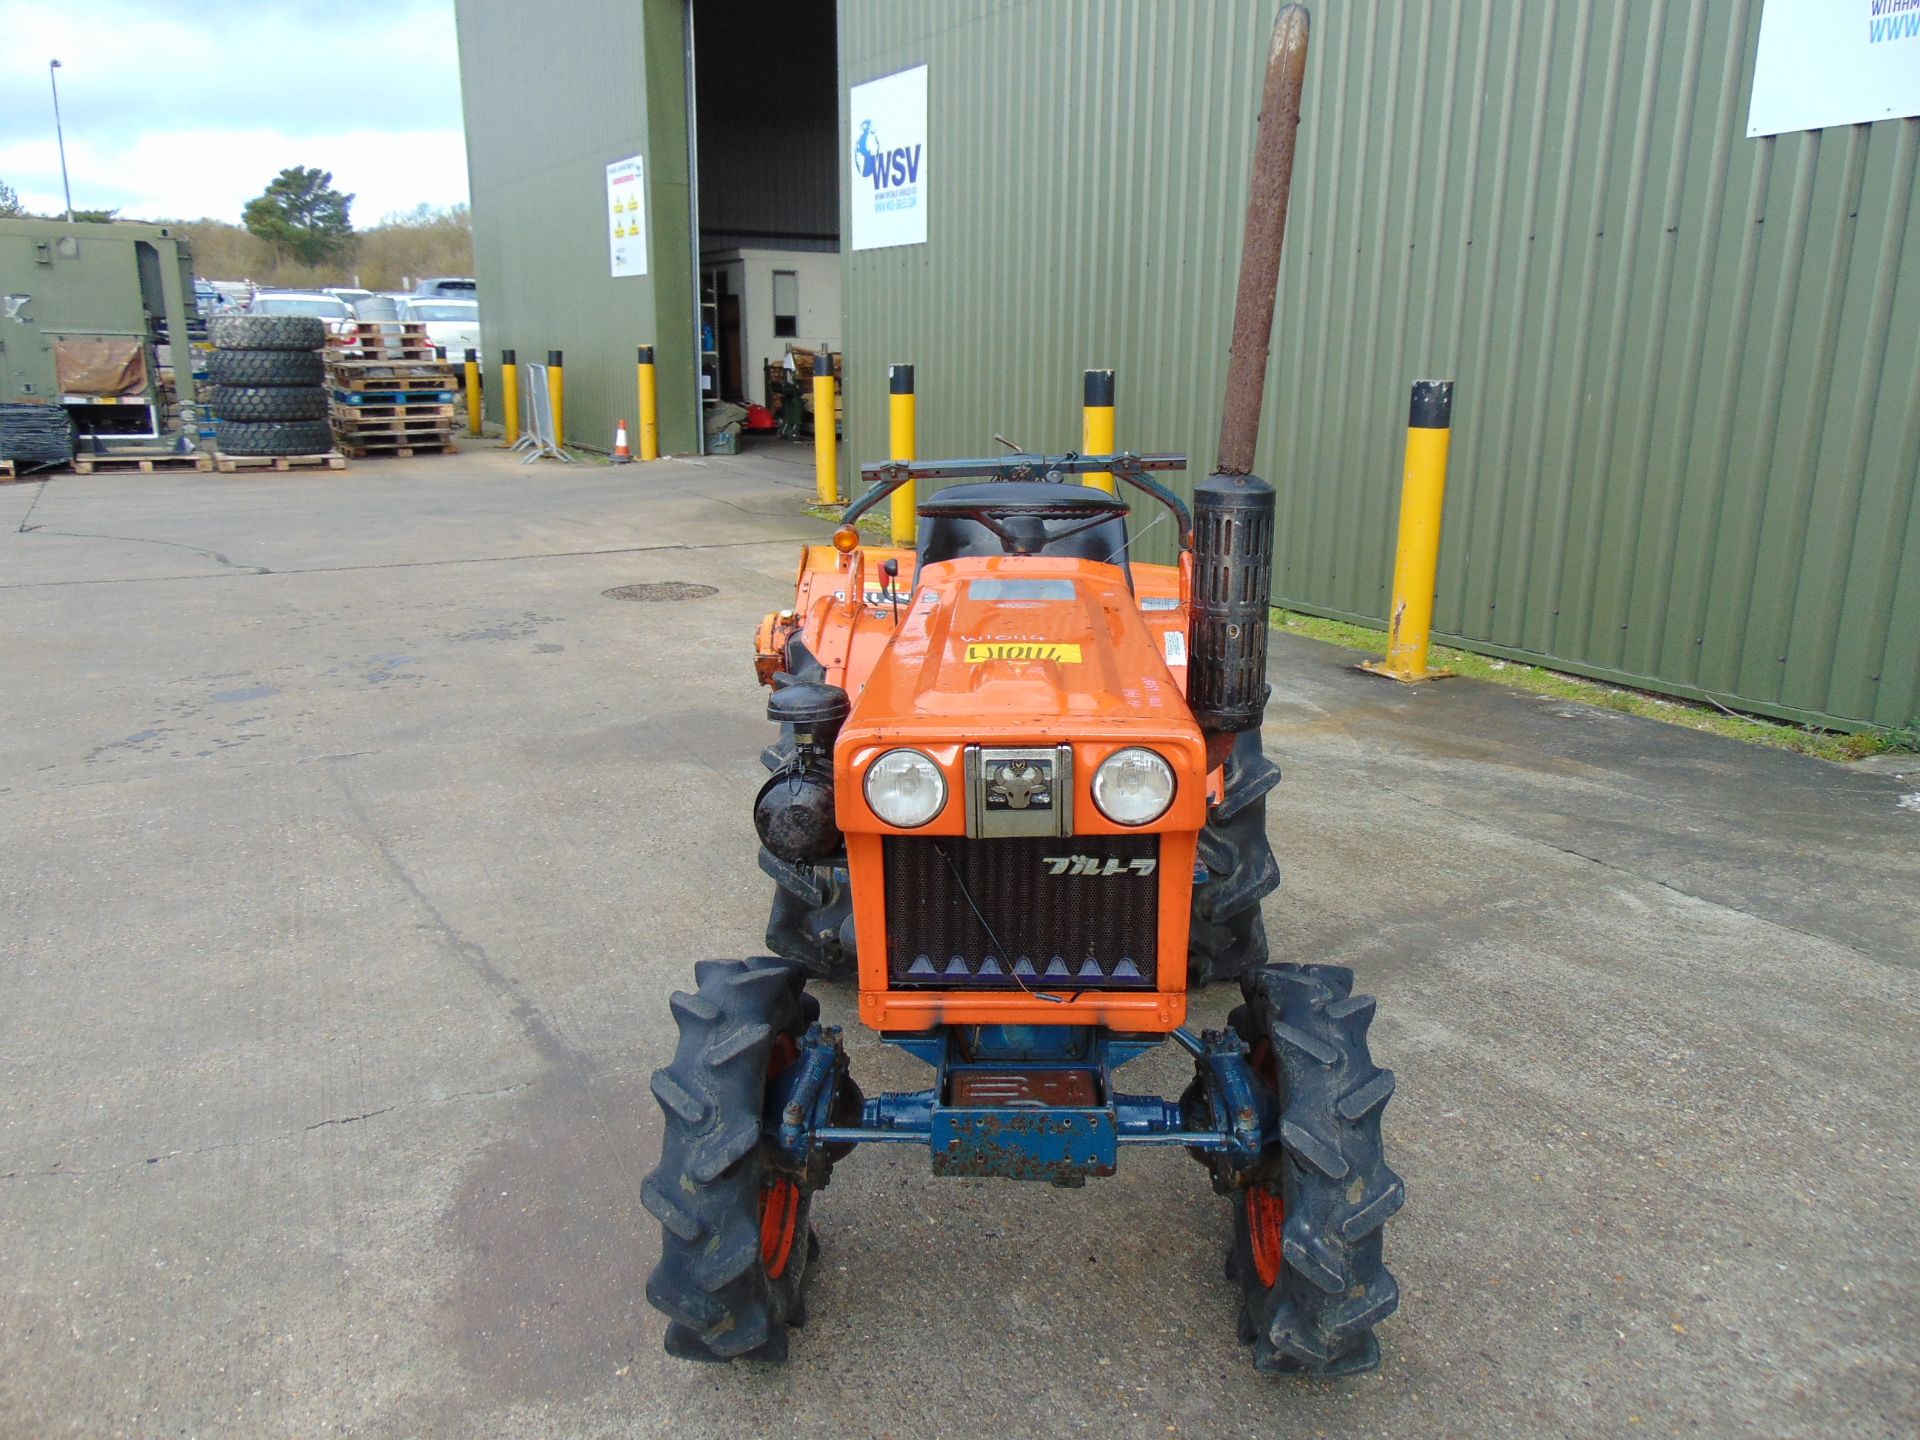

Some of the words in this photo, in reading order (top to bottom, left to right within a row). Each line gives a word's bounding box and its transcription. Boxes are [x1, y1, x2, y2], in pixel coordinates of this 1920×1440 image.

[872, 144, 921, 190] WSV
[1042, 855, 1157, 876] ブルトラ
